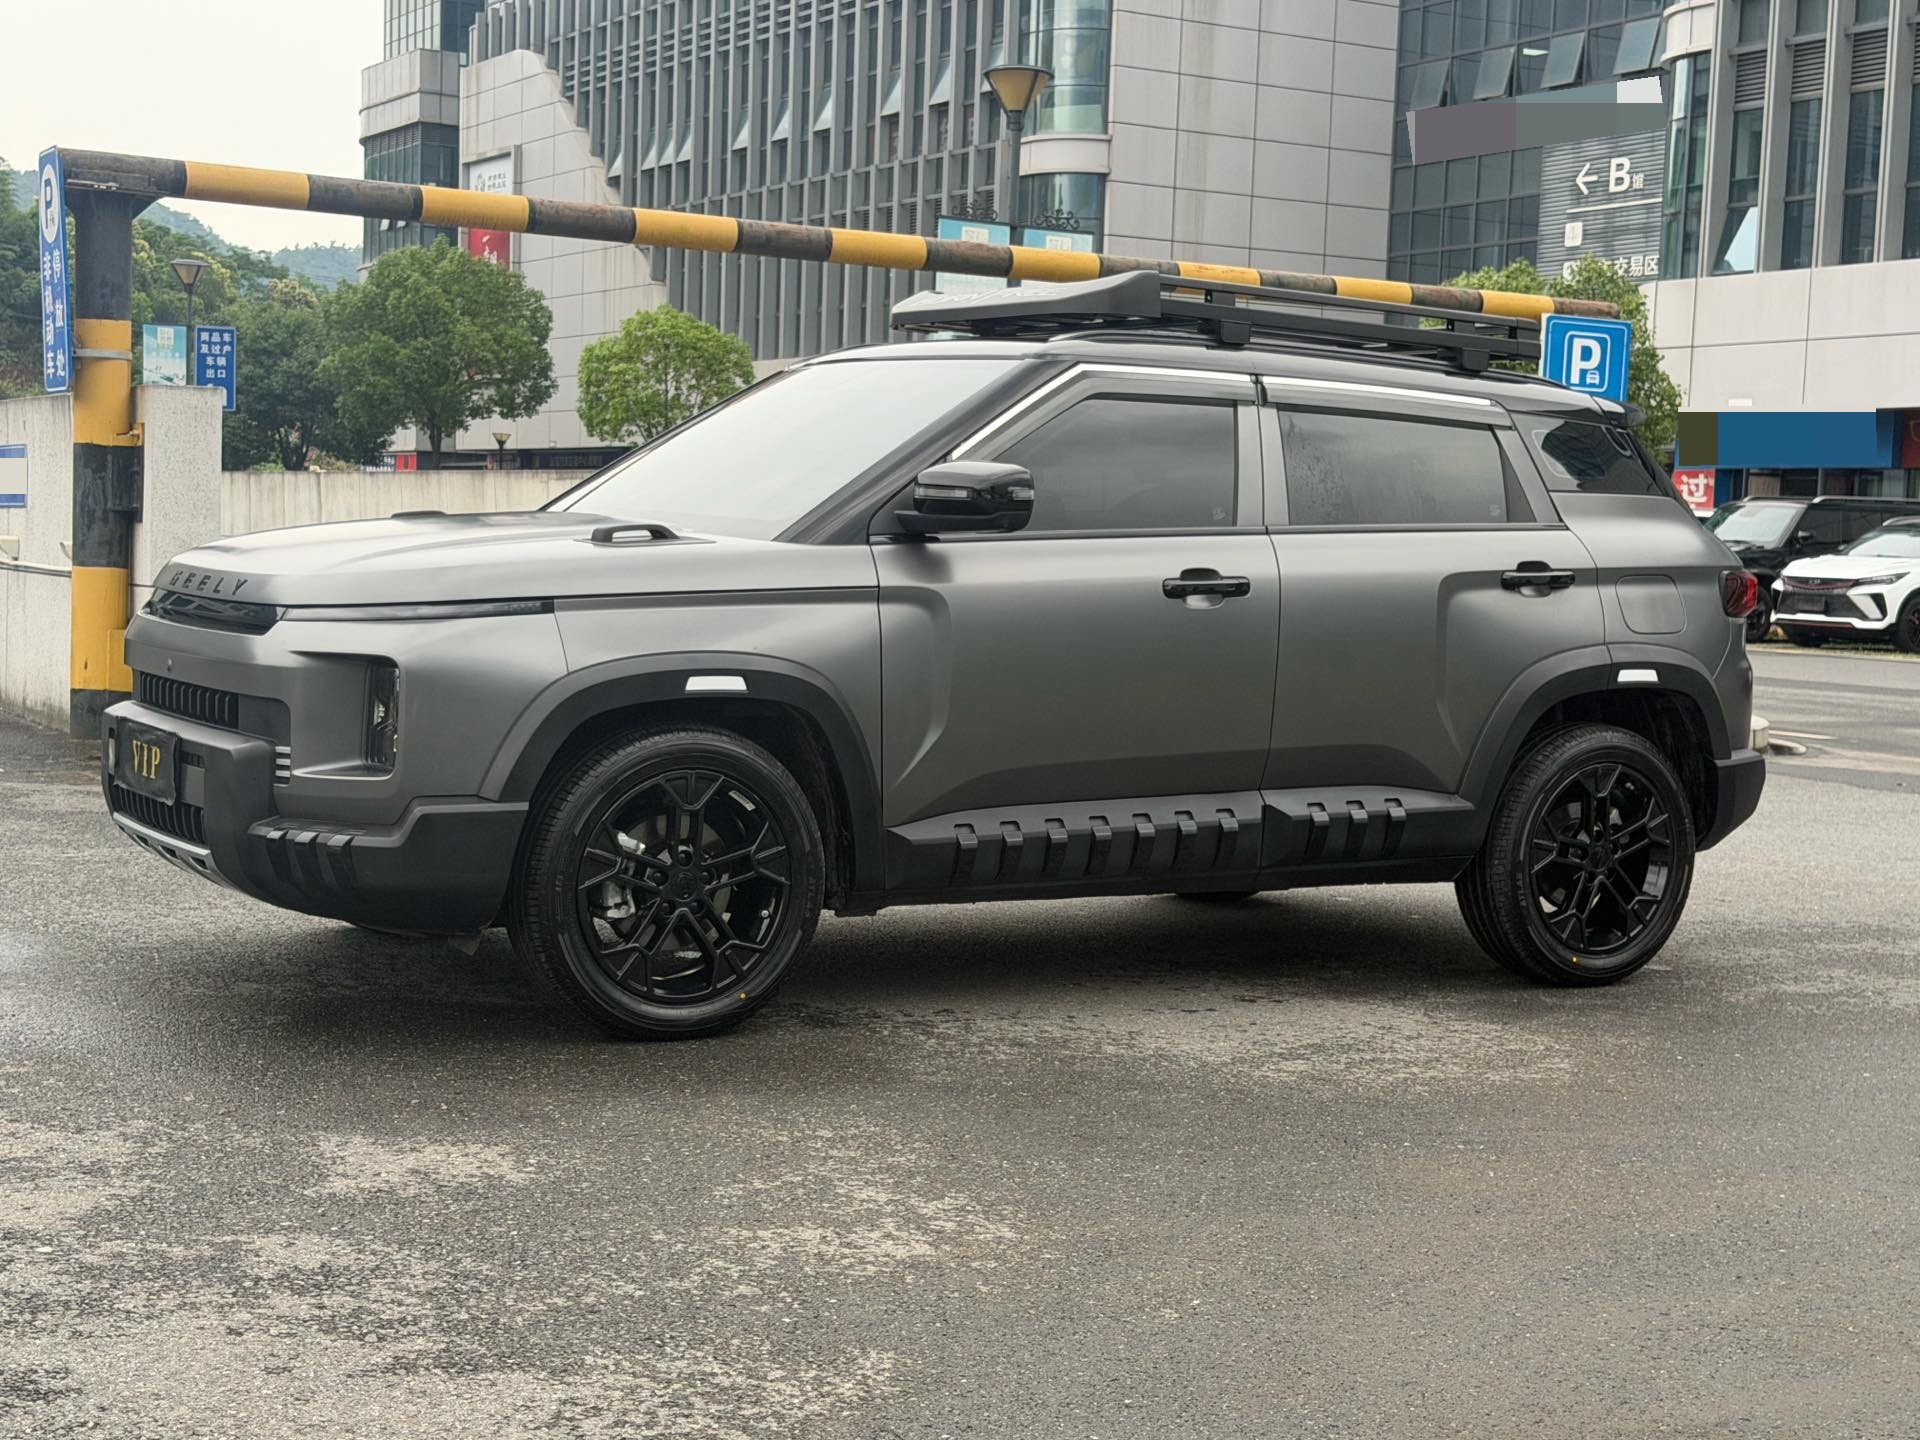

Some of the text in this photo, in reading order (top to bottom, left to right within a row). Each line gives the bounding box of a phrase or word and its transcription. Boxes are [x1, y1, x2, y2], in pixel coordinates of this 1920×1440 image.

[44, 177, 53, 230] P
[1602, 255, 1659, 279] 交易区
[200, 344, 232, 355] 及过户
[206, 355, 227, 367] 车辆
[1570, 337, 1602, 385] P
[206, 367, 227, 379] 出口
[1680, 473, 1708, 504] 过
[169, 570, 249, 596] GEELY
[133, 740, 161, 780] VIP
